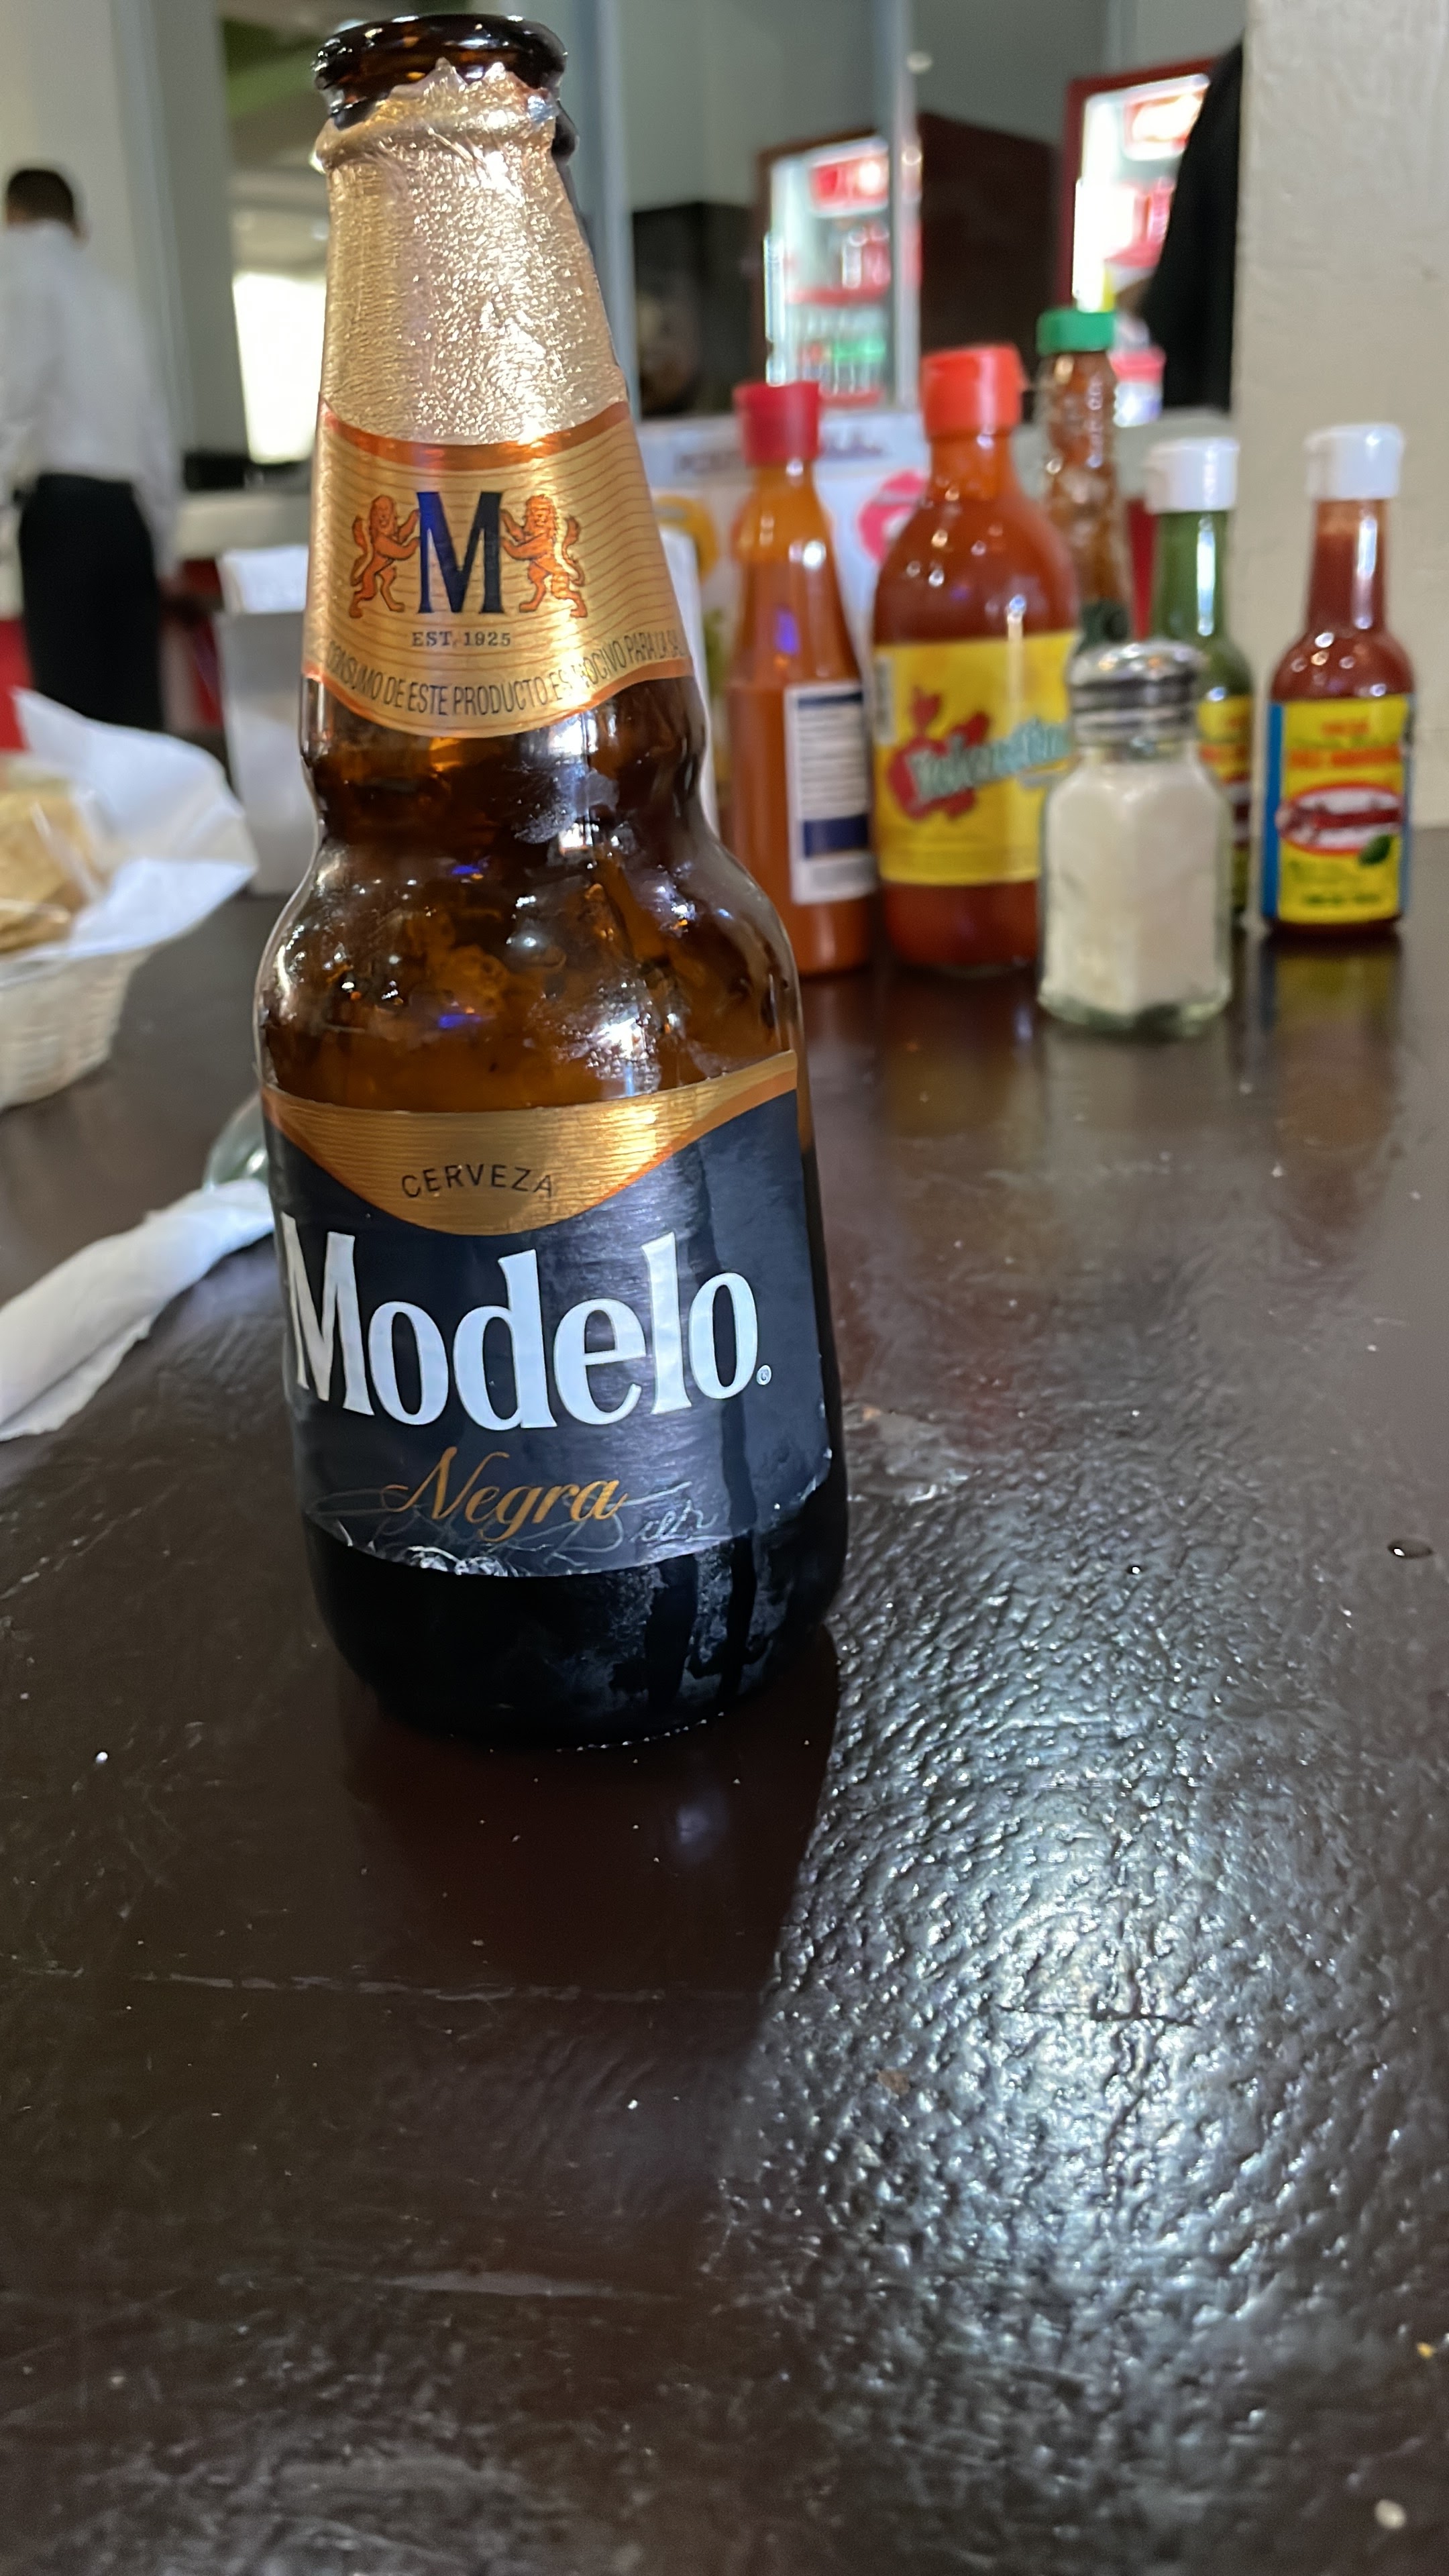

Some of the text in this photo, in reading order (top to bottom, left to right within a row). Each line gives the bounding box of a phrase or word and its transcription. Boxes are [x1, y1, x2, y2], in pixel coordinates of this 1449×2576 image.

[416, 491, 505, 614] M
[464, 631, 511, 647] 1925
[383, 676, 406, 708] DE
[407, 682, 449, 716] ESTE
[453, 676, 549, 716] PRODUCTO
[402, 1163, 552, 1198] CERVEZA
[280, 1211, 758, 1432] Modelo
[380, 1446, 629, 1542] Negra
